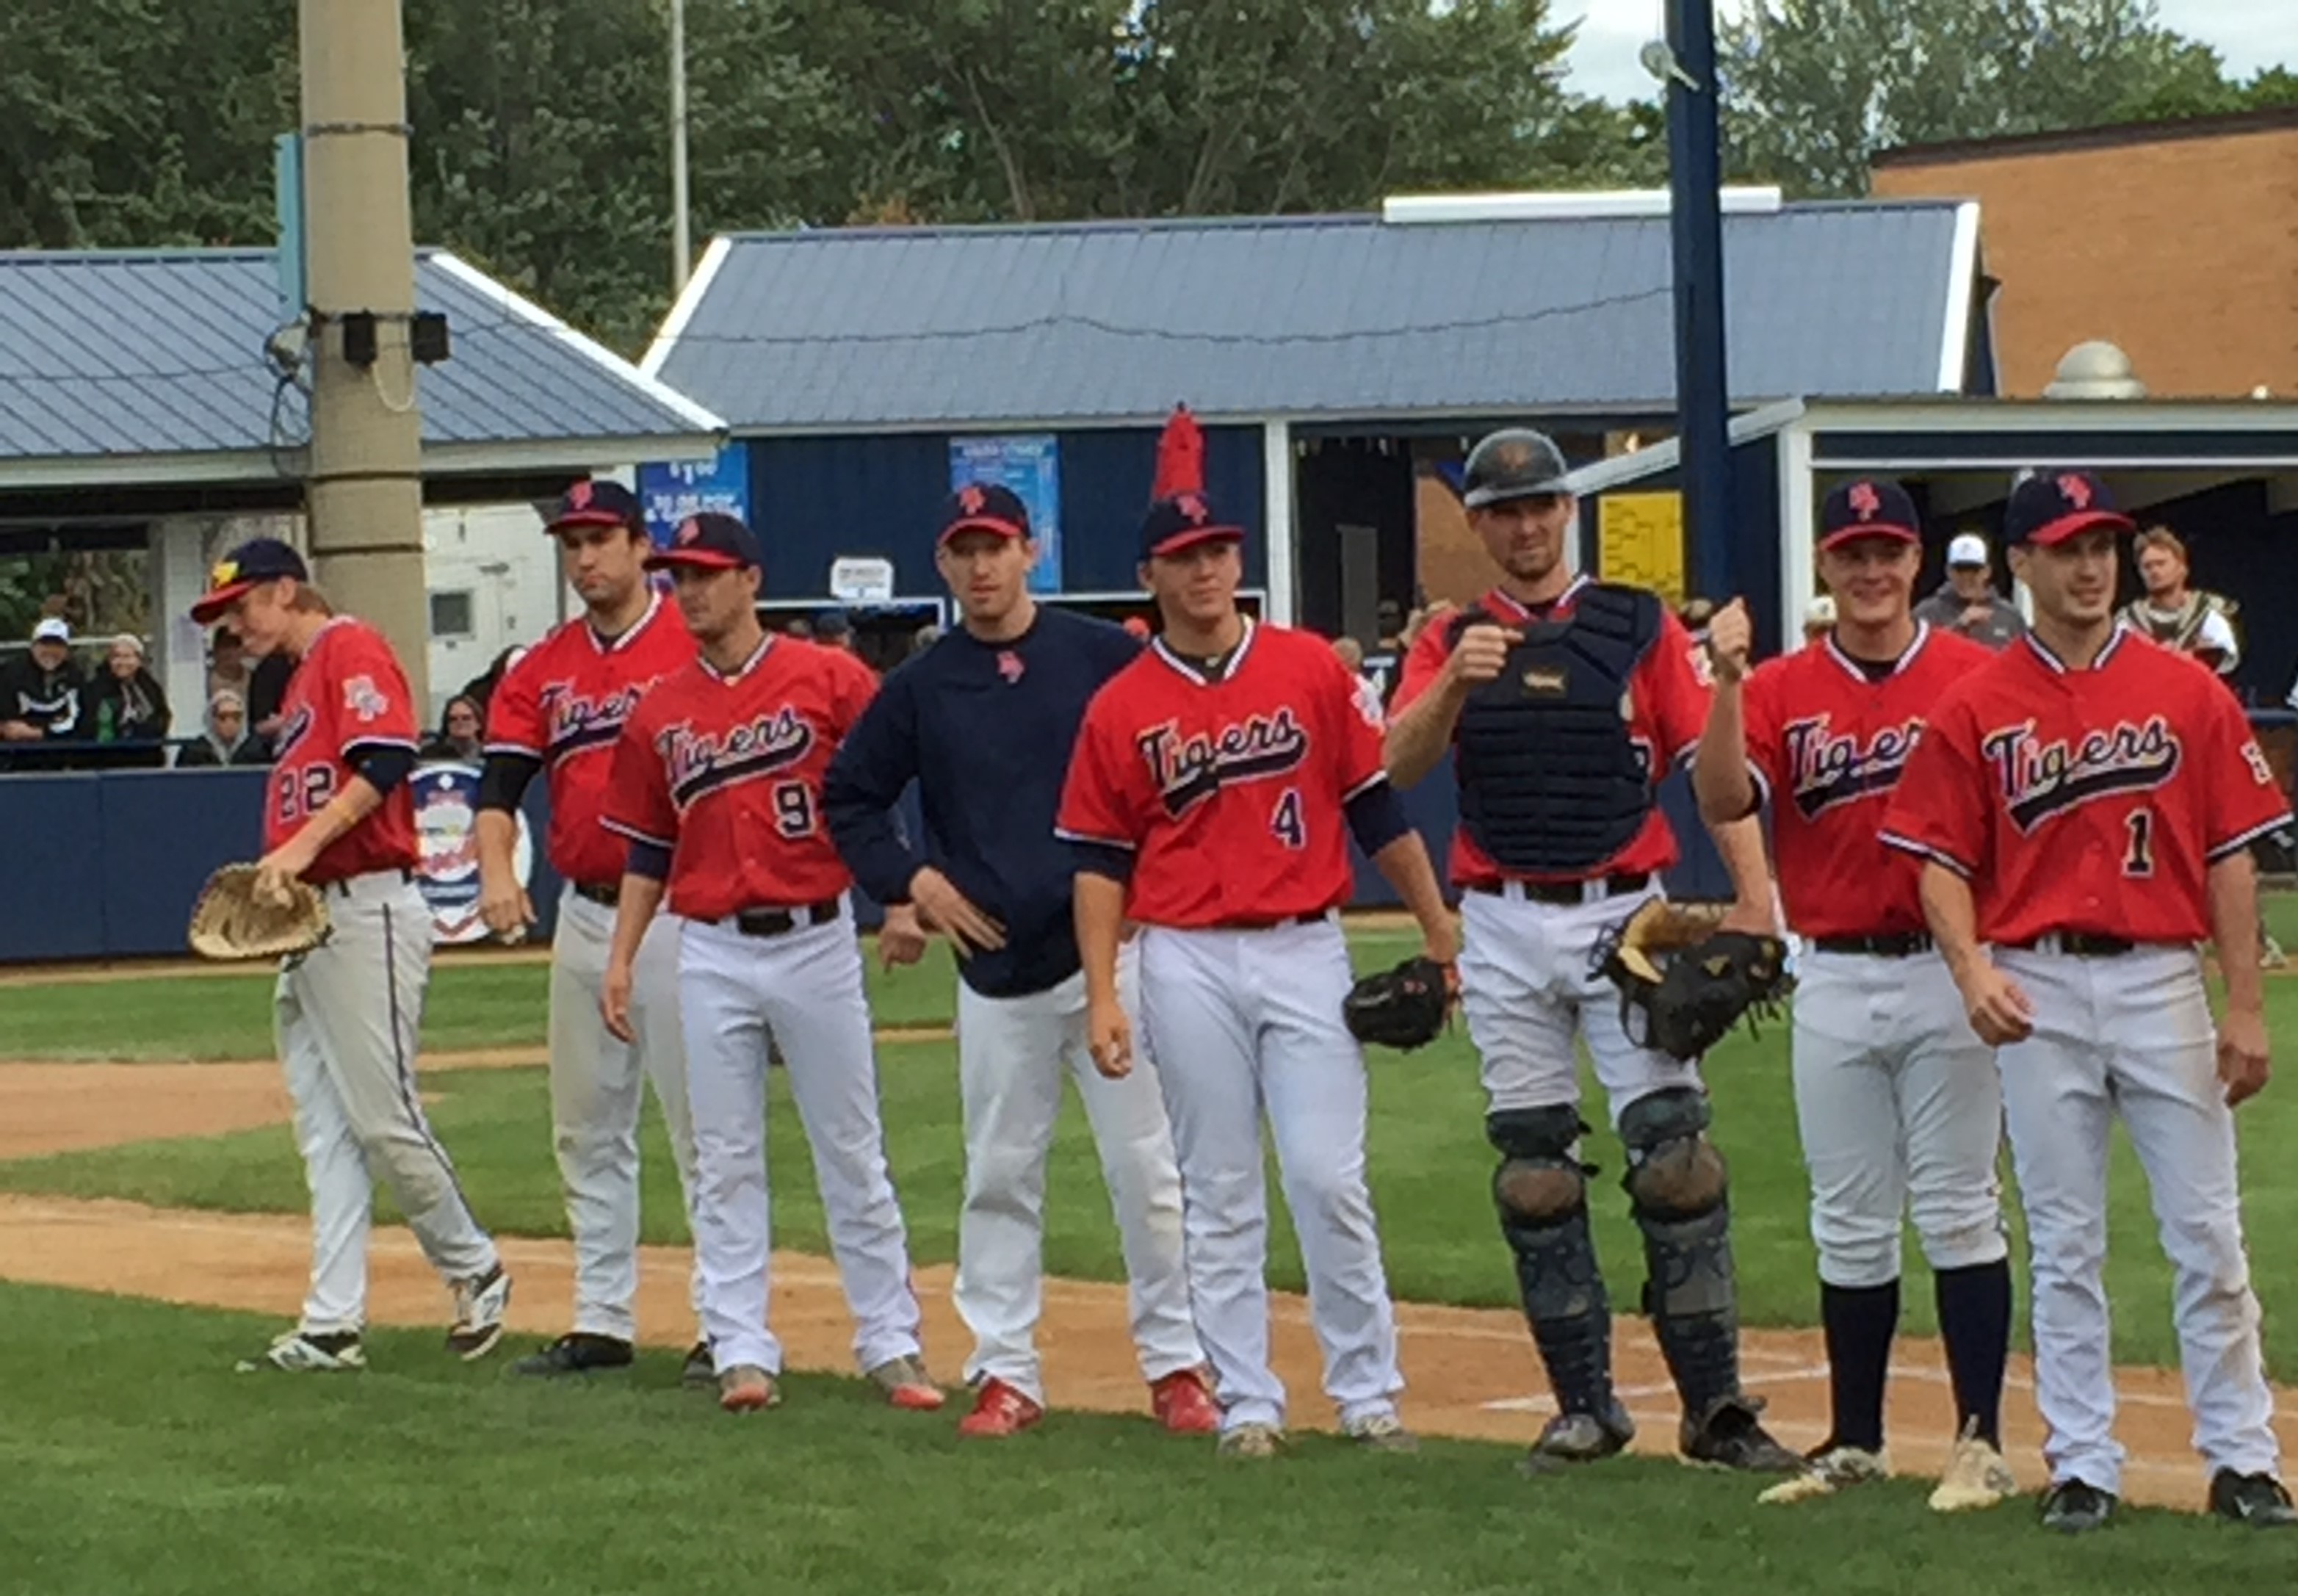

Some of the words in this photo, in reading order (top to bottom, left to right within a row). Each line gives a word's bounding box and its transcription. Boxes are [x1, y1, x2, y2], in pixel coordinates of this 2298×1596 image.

[657, 703, 814, 797] Tigers
[1137, 705, 1309, 804] Tigers
[1782, 712, 1927, 804] Tiger
[1982, 714, 2180, 815] Tigers
[278, 761, 336, 824] 22
[773, 780, 815, 837] 9
[1271, 787, 1305, 848] 4
[2122, 806, 2153, 878] 1
